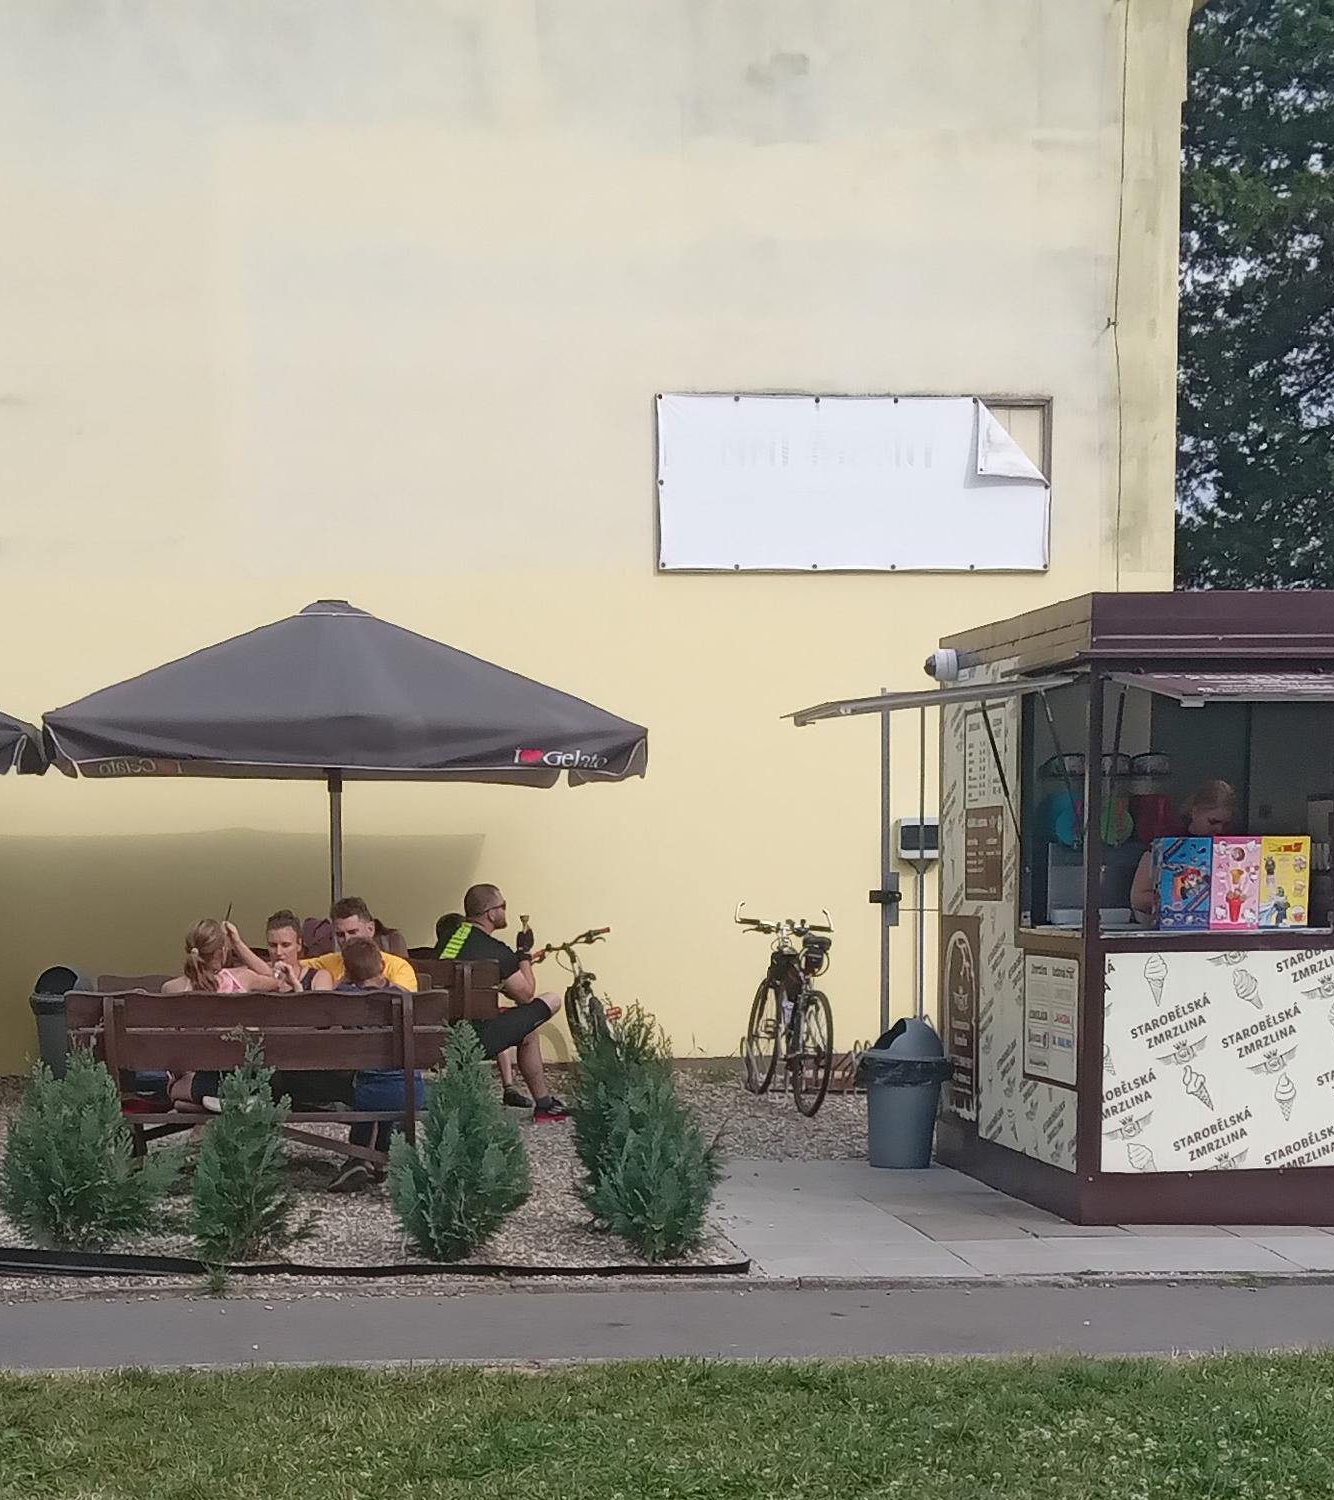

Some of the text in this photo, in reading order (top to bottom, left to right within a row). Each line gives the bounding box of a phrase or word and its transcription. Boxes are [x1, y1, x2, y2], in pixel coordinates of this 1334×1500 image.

[514, 749, 608, 768] I Gelato
[1130, 992, 1211, 1040] STAROBĚLSKÁ
[1146, 1014, 1207, 1050] ZMRZLINA
[1221, 1002, 1302, 1049] STAROBĚLSKÁ
[1236, 1023, 1297, 1059] ZMRZLINA
[1172, 1105, 1253, 1152] STAROBĚLSKÁ
[1188, 1126, 1248, 1162] ZMRZLINA
